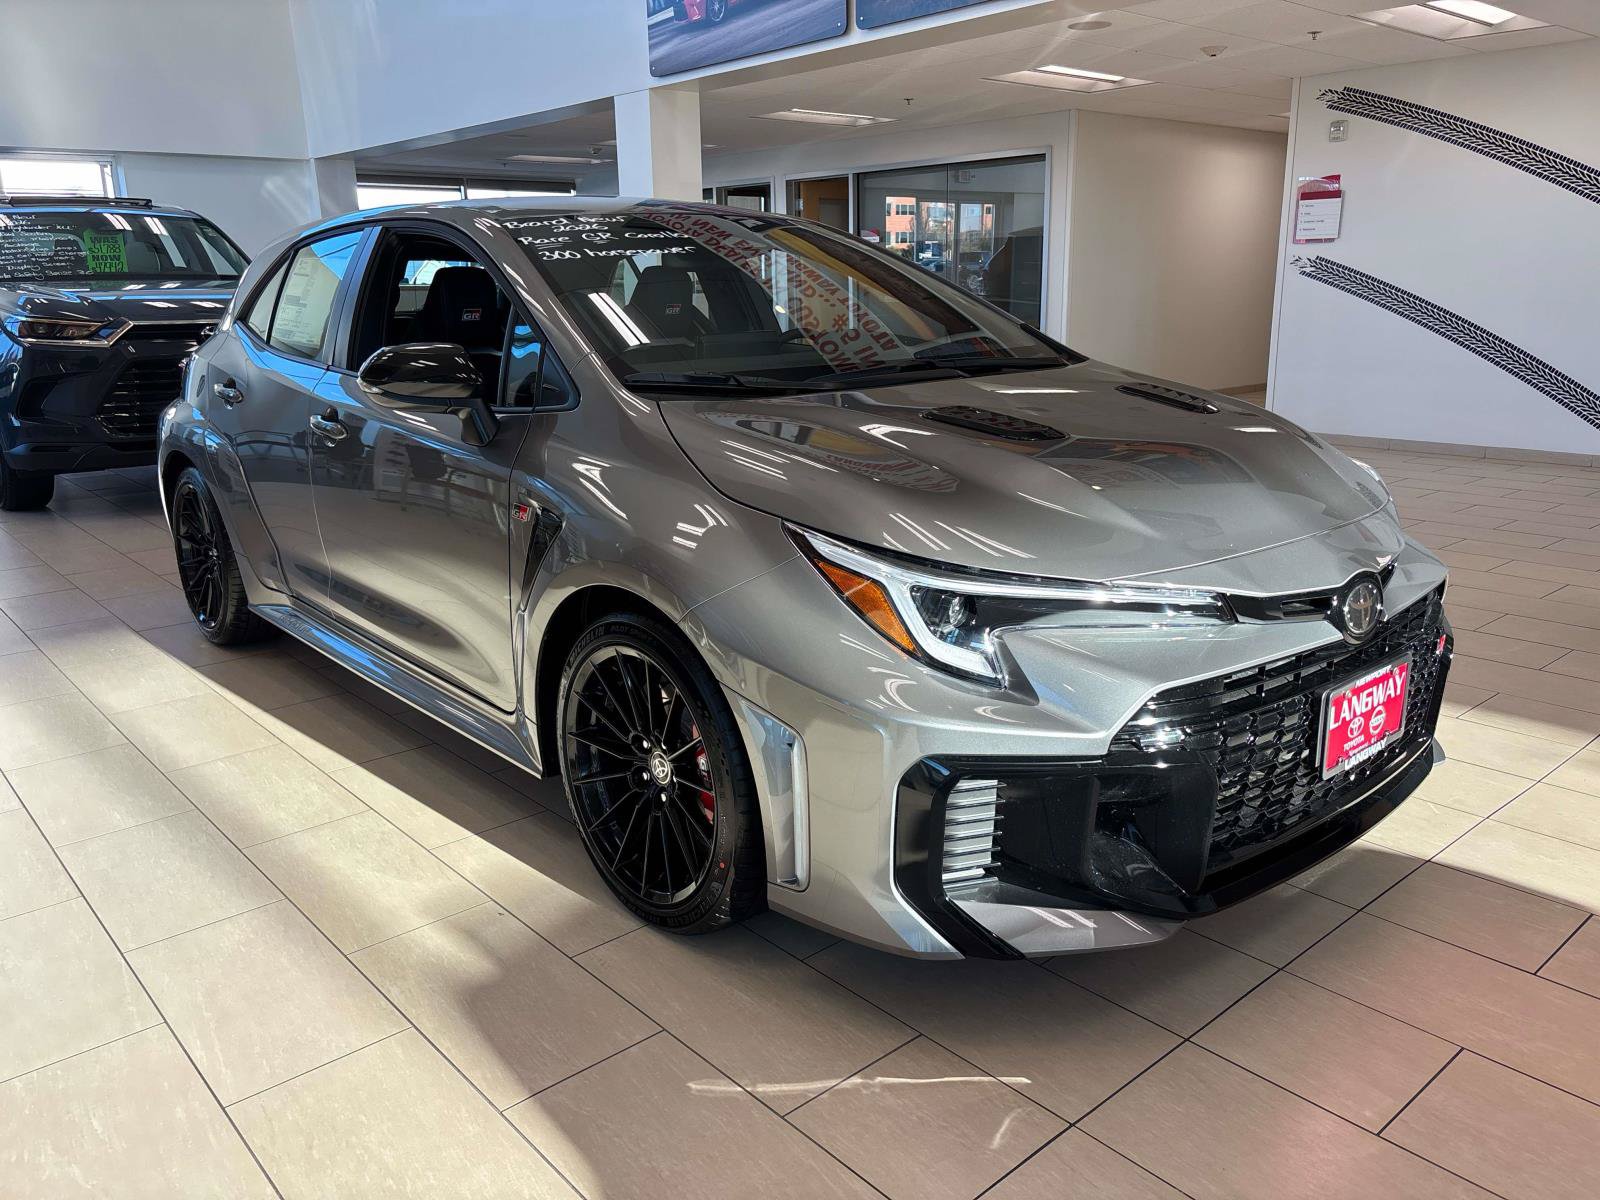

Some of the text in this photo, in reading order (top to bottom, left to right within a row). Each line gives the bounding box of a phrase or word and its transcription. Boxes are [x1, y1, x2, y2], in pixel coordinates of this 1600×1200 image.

[551, 223, 609, 233] 2026
[517, 230, 691, 246] Rare GR Corolla
[92, 254, 121, 262] NOW
[538, 245, 697, 261] 300 horsepower
[462, 310, 481, 320] GR
[512, 505, 529, 521] GR
[1329, 671, 1406, 731] LANGWAY
[1343, 734, 1365, 752] TOYOTA
[1344, 736, 1388, 771] LANGWAY
